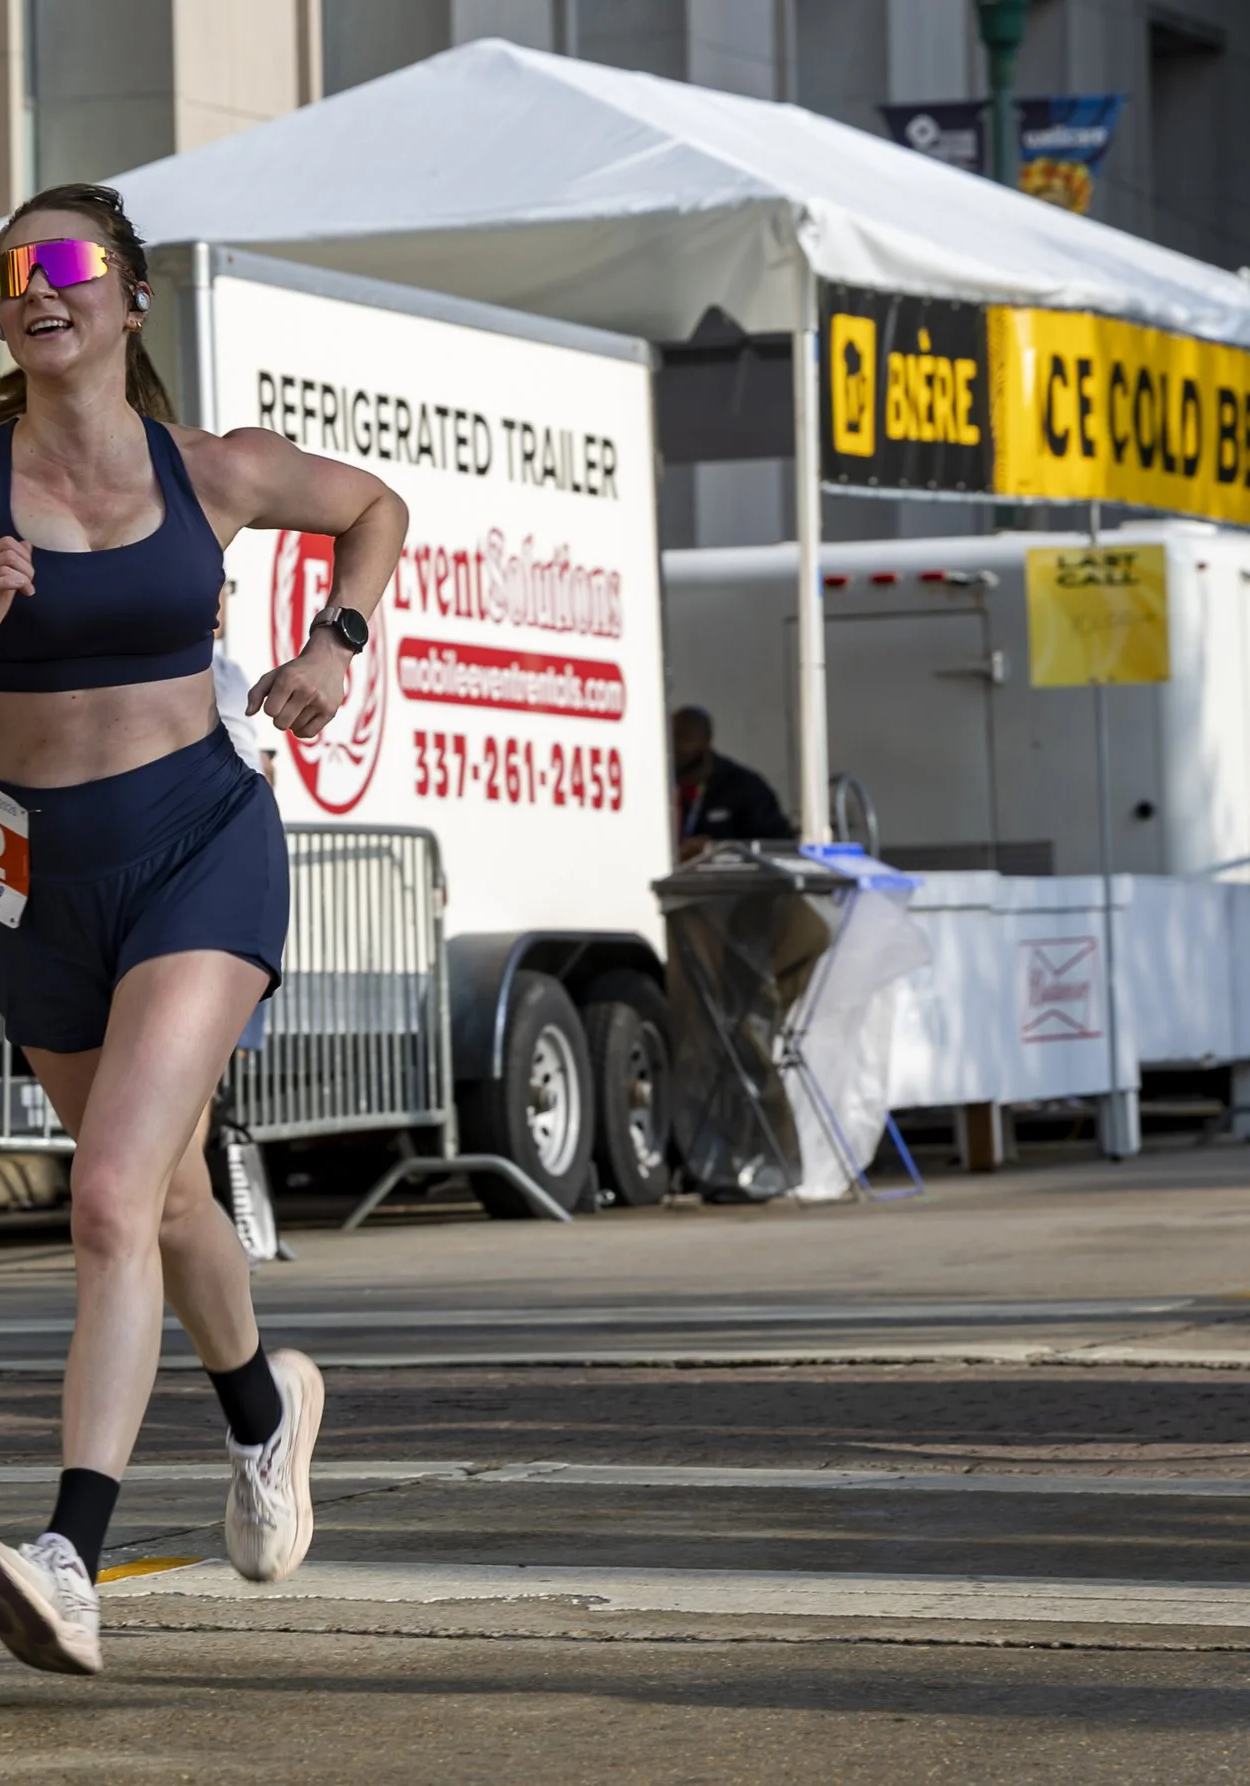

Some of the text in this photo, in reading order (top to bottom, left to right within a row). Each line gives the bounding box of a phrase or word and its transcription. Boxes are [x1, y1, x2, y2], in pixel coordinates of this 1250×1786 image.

[257, 370, 619, 500] REFRIGERATED TRAILER
[886, 327, 981, 446] BIÈRE
[1108, 360, 1202, 479] COLD
[413, 730, 624, 814] 337-261-2459
